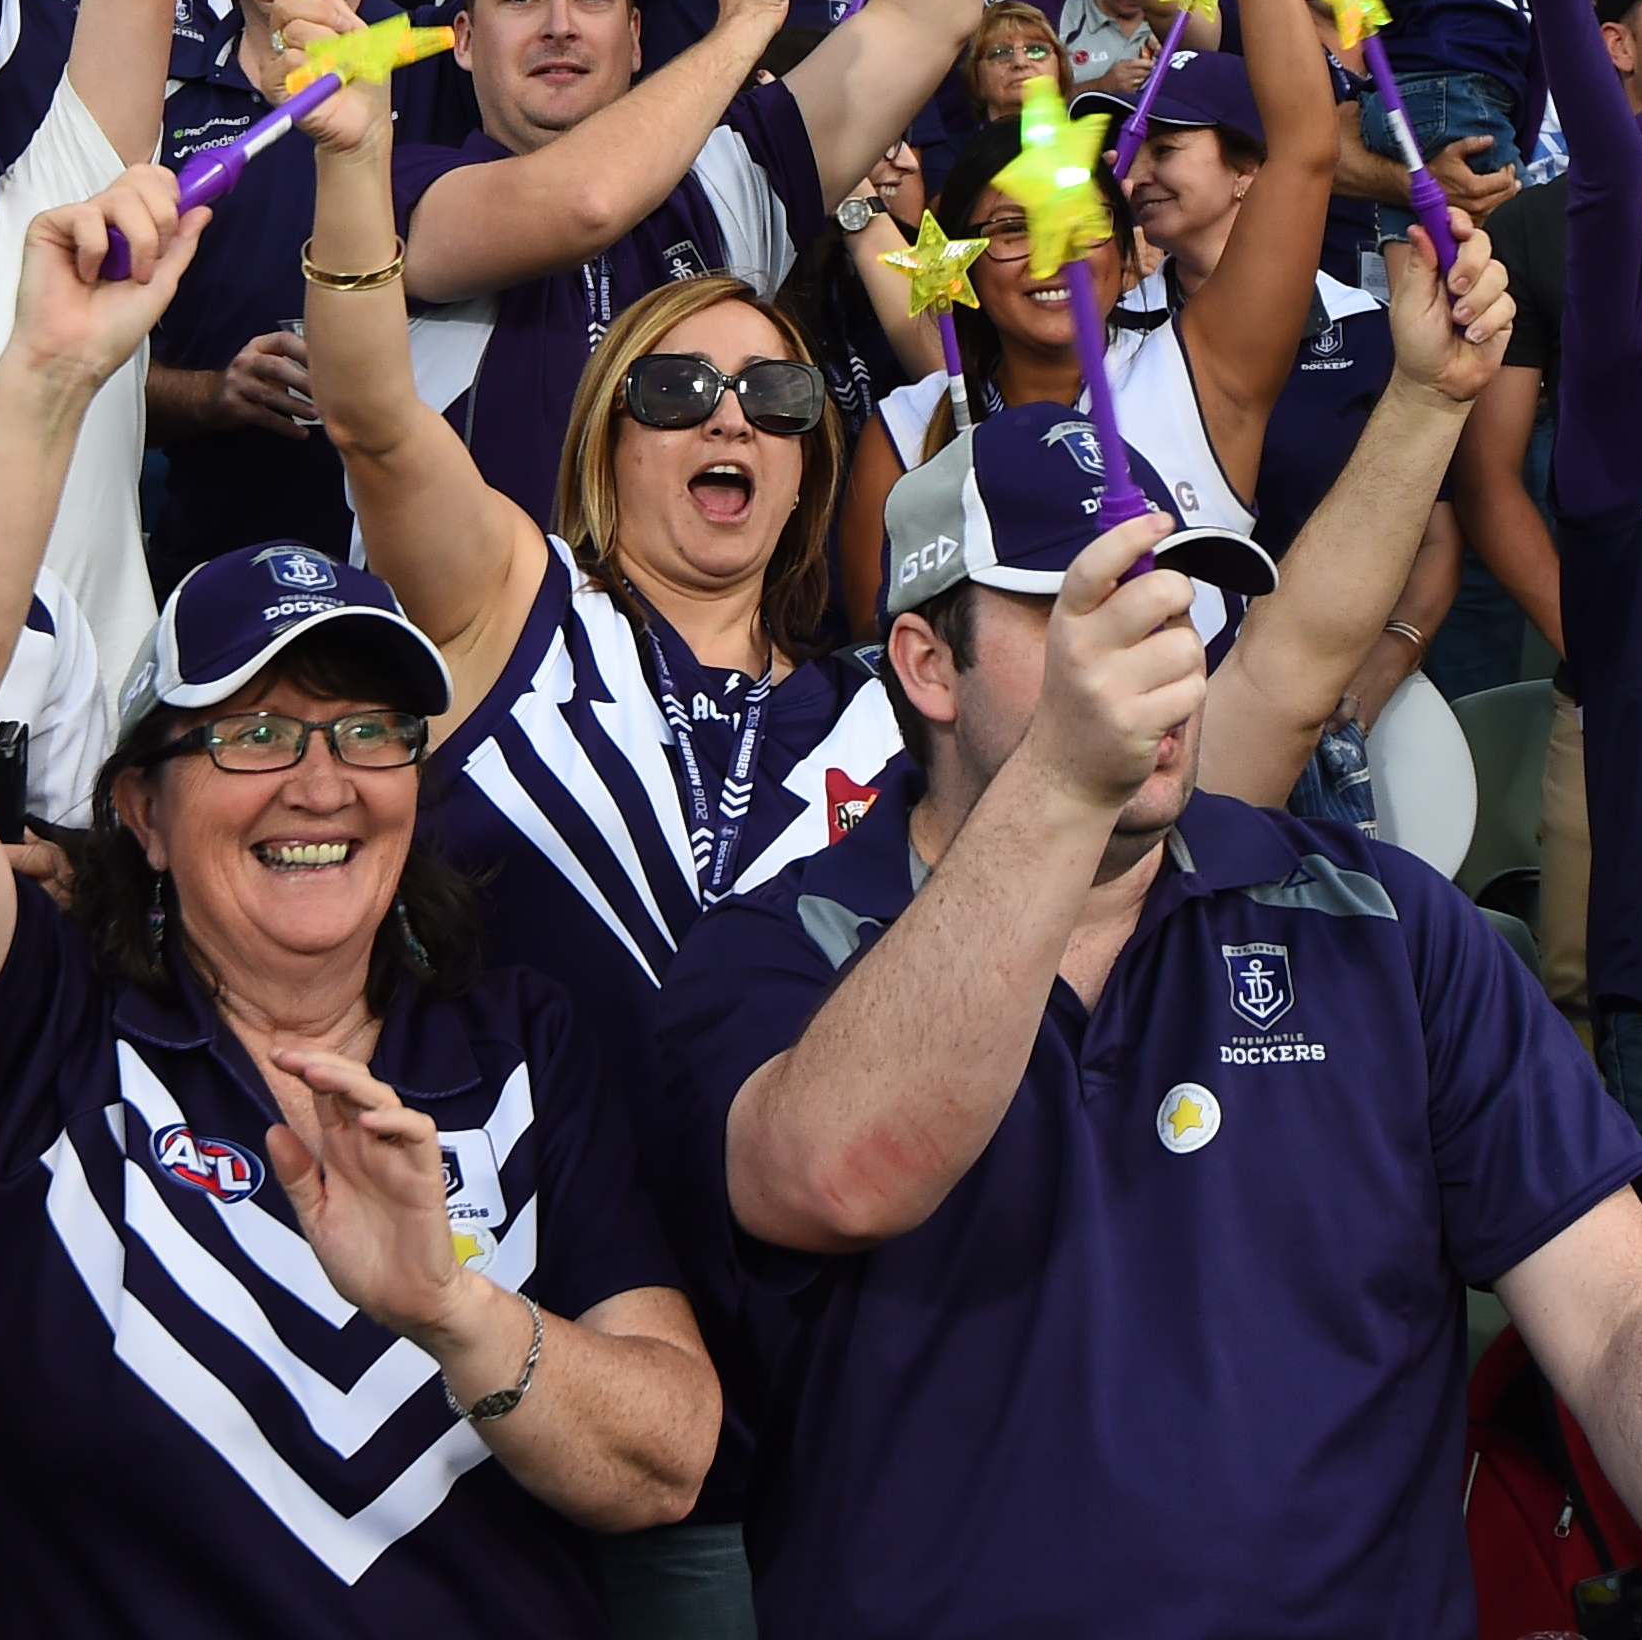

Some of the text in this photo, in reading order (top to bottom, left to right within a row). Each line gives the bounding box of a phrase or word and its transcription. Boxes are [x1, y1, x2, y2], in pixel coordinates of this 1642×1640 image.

[191, 130, 247, 154] woodsid
[600, 274, 611, 321] MEMBER
[734, 705, 762, 779] 2016 MEMBER
[677, 731, 709, 821] 2016 MEMBER
[712, 840, 729, 886] DOCKERS
[1219, 1043, 1326, 1065] DOCKERS
[1231, 1033, 1305, 1046] FREMANTLE
[159, 1133, 252, 1192] AFL
